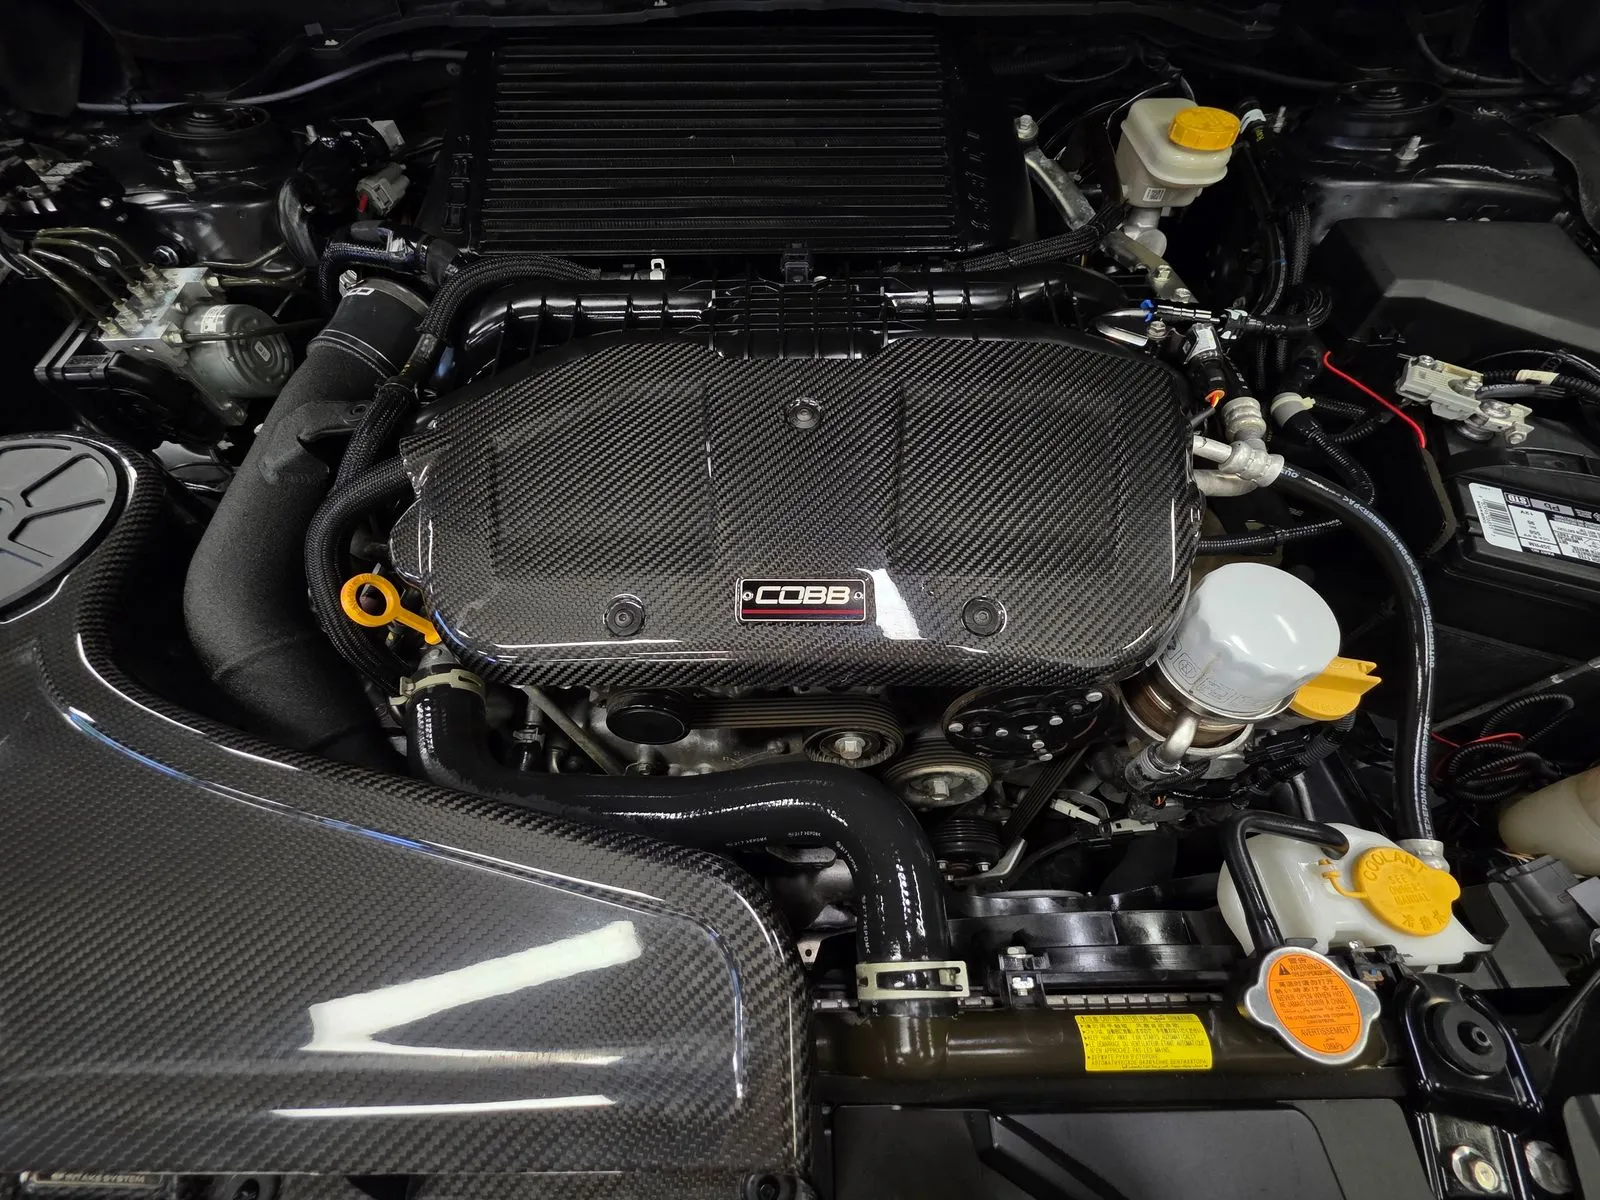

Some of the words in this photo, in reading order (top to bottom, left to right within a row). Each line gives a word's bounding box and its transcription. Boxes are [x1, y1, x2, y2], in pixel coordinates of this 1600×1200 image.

[1544, 503, 1561, 512] Pb
[754, 585, 851, 605] COBB
[1363, 850, 1428, 881] COOLANT
[1387, 874, 1408, 884] SEE
[1394, 893, 1431, 905] MANUAL
[1300, 1026, 1351, 1036] AVERTISSEMENT
